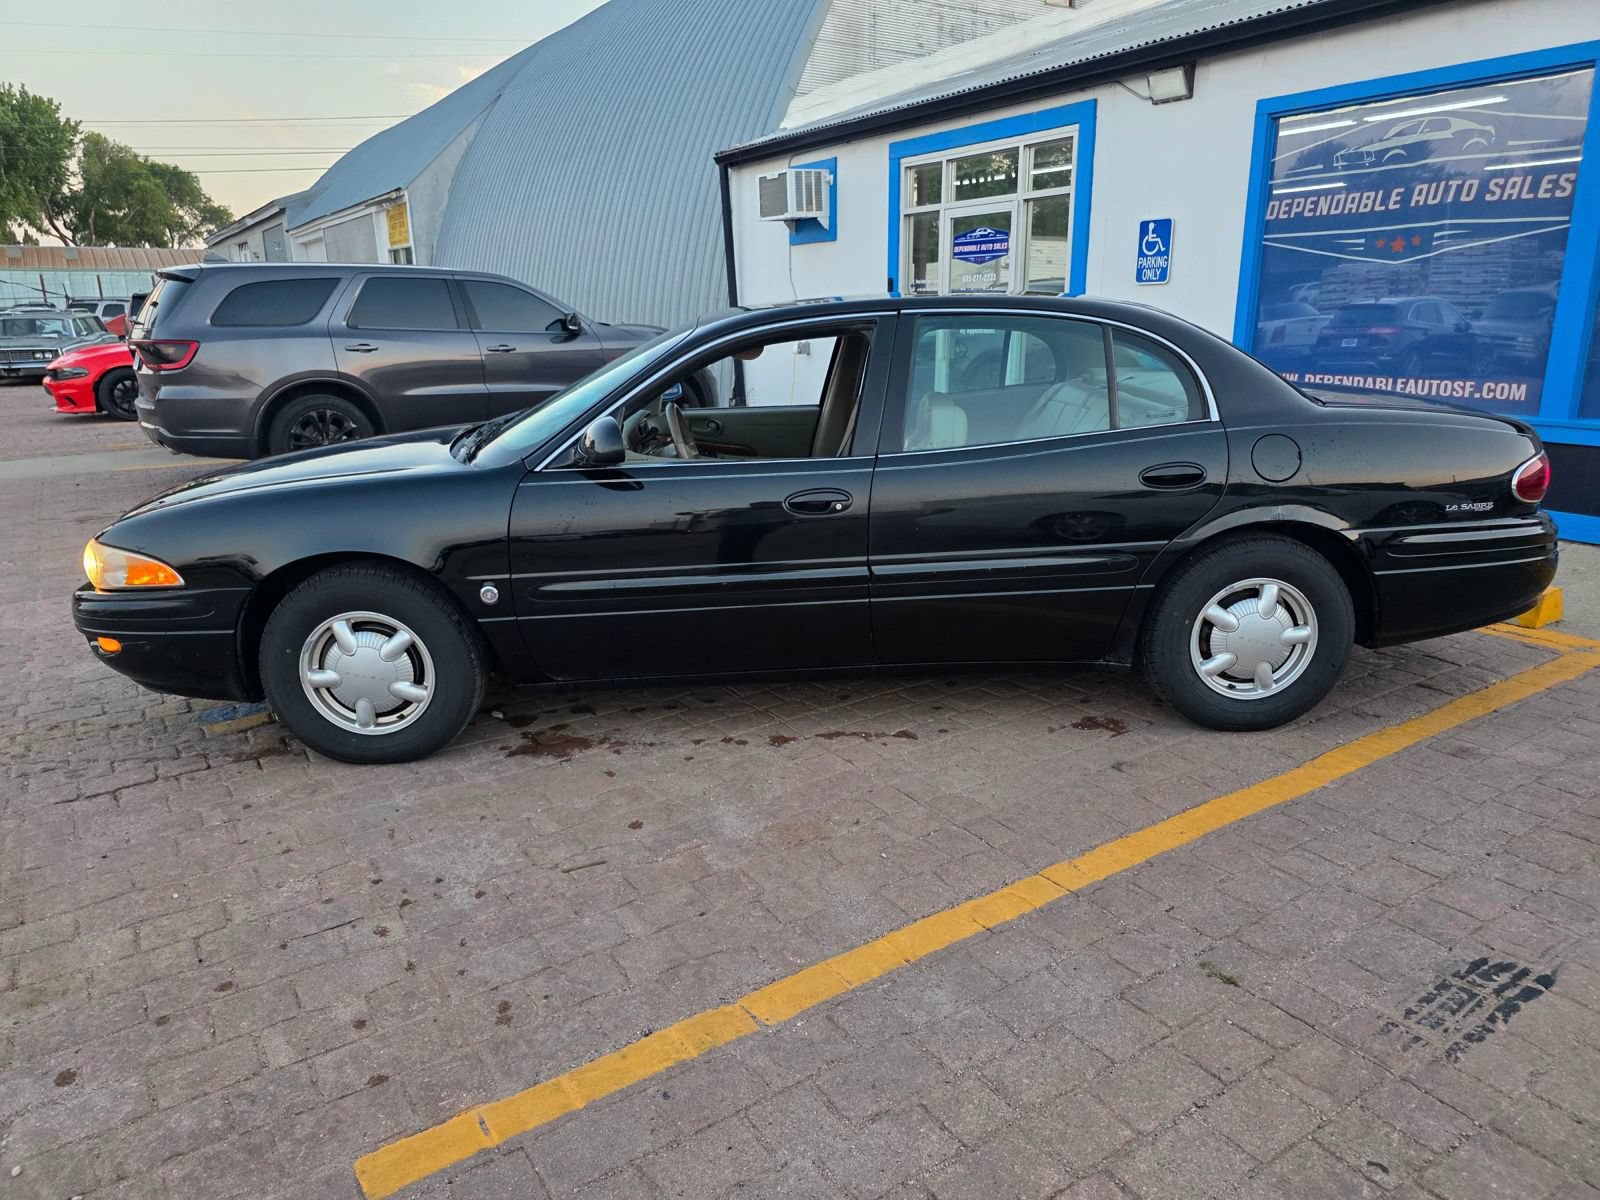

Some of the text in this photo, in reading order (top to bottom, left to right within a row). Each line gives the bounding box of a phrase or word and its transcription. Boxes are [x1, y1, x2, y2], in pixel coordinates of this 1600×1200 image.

[1265, 173, 1577, 220] DEPENDABLE AUTO SALES
[980, 243, 993, 251] AUTO
[993, 242, 1008, 250] SALES
[1137, 255, 1168, 269] PARKING
[1142, 268, 1162, 281] ONLY
